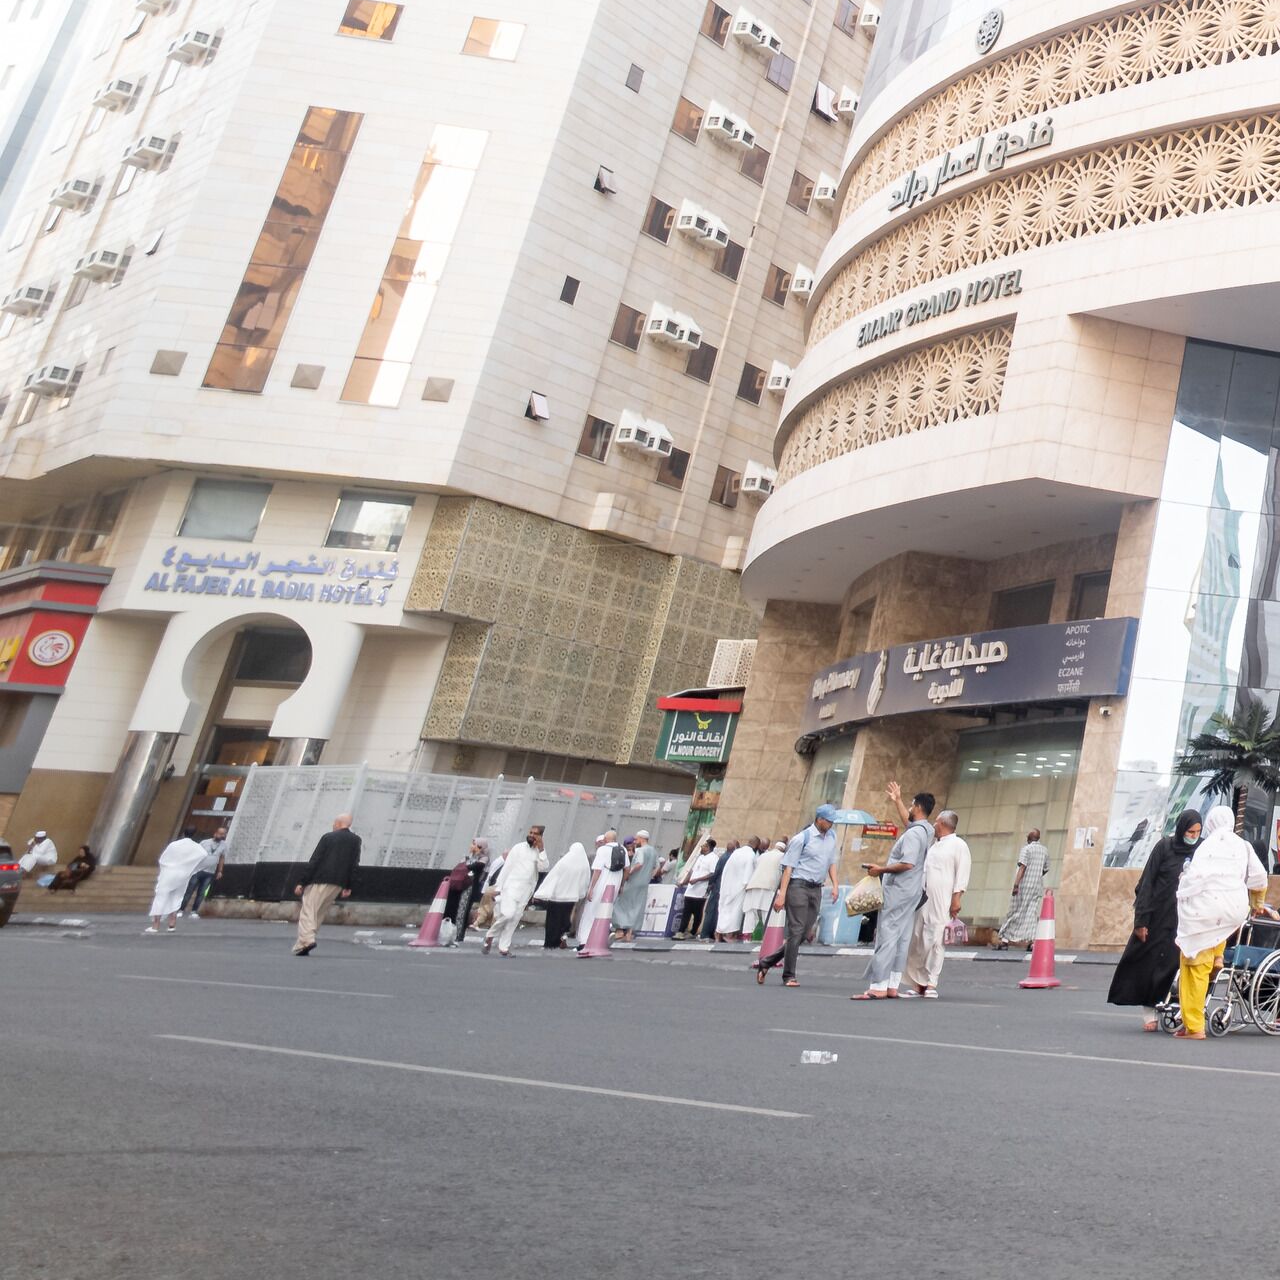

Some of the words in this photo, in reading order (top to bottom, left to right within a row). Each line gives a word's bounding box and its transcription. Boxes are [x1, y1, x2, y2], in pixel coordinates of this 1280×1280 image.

[984, 116, 1054, 172] فندق
[856, 308, 903, 348] EMAAR
[906, 286, 962, 327] GRAND
[964, 269, 1023, 307] HOTEL
[175, 551, 261, 575] البديع
[259, 554, 338, 577] الفجر
[338, 557, 400, 582] فندق
[144, 571, 172, 591] AL
[172, 574, 232, 596] FAJER
[232, 577, 258, 598] AL
[260, 579, 315, 602] BADIA
[318, 583, 374, 606] HOTEL
[1065, 624, 1091, 635] APOTIC
[941, 636, 1009, 677] صيدلية
[1058, 666, 1084, 677] ECZANE
[671, 730, 697, 744] النور
[697, 731, 724, 745] بقالة
[694, 745, 722, 758] GROCERY
